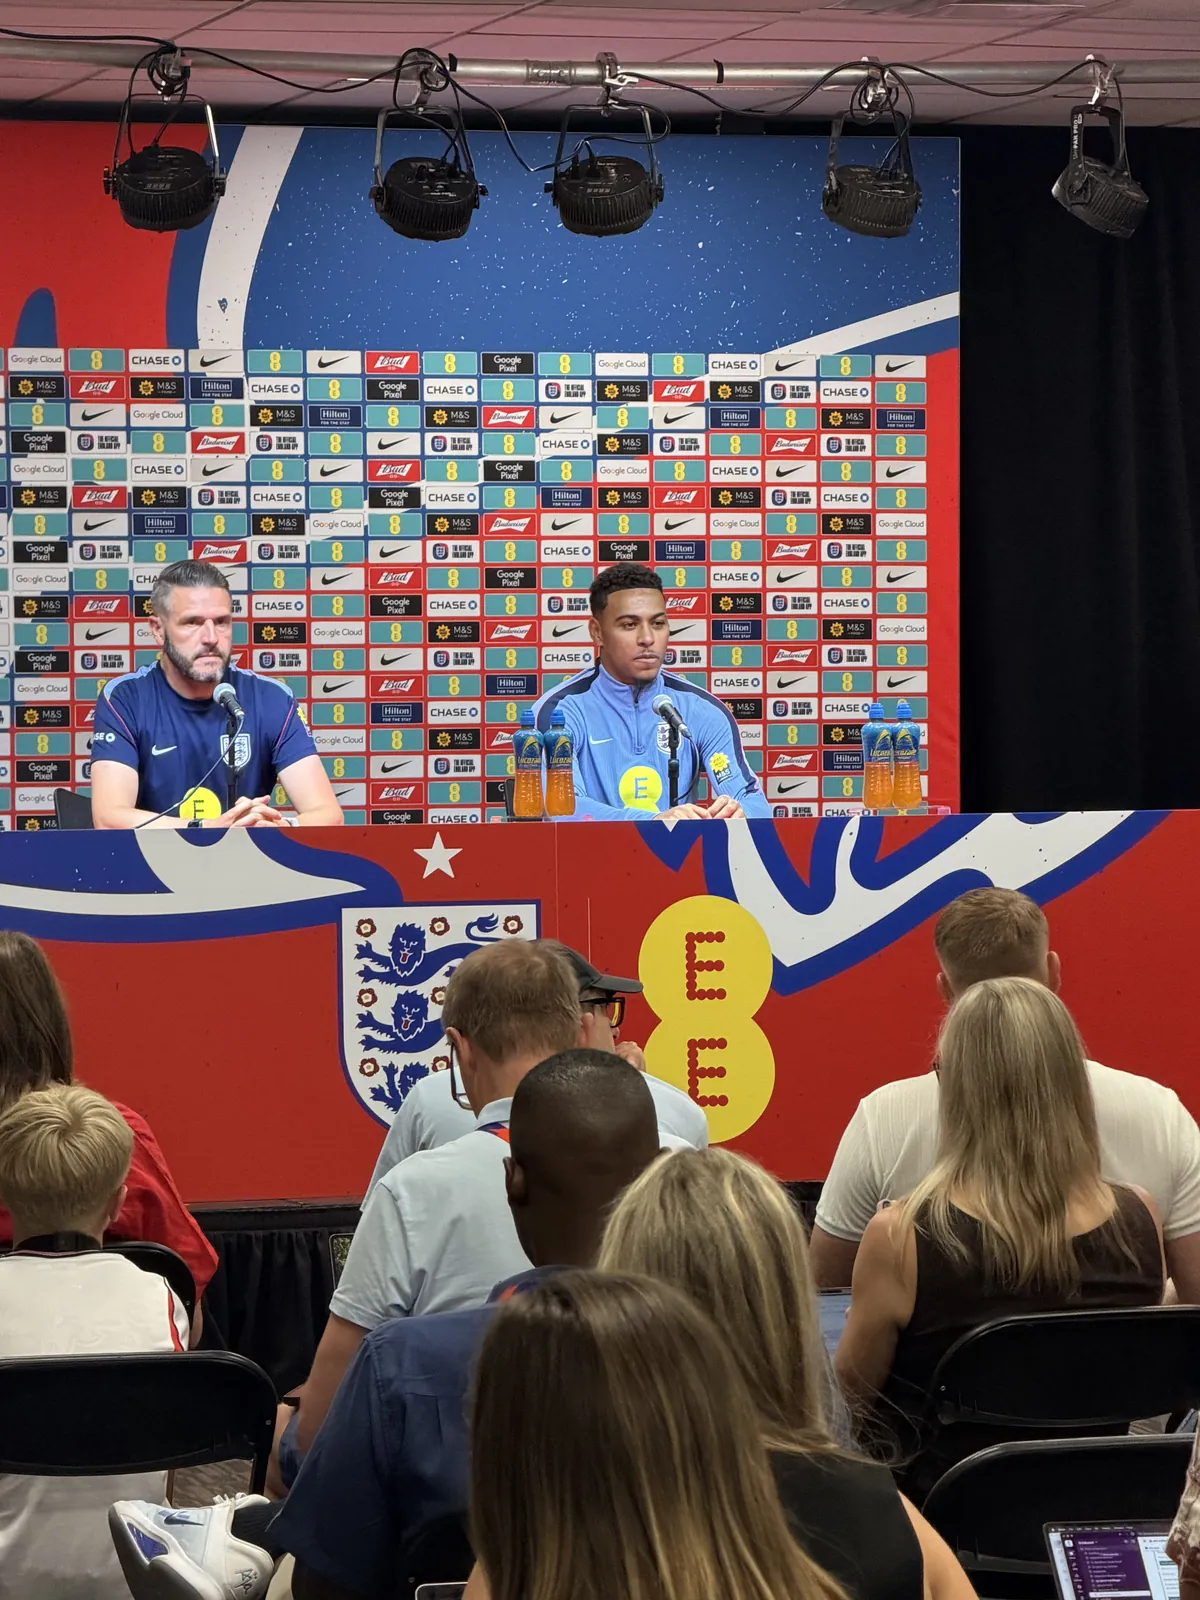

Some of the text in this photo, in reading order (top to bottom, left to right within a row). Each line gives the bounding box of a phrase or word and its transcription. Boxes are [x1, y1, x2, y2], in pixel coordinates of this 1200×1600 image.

[11, 354, 37, 364] Google
[132, 356, 169, 364] CHASE
[494, 355, 521, 364] Google
[598, 359, 623, 368] Google
[499, 364, 516, 372] Pixel
[157, 381, 176, 389] M&S
[251, 384, 288, 392] CHASE
[378, 381, 406, 390] Google
[734, 385, 752, 393] M&S
[384, 390, 401, 398] Pixel
[133, 410, 182, 419] Google Cloud
[276, 409, 295, 417] M&S
[846, 412, 863, 420] M&S
[23, 434, 52, 443] Google
[201, 437, 236, 445] Budweiser
[622, 438, 641, 446] M&S
[775, 439, 808, 447] Budweiser
[14, 465, 40, 474] Google
[134, 465, 171, 473] CHASE
[495, 463, 522, 471] Google
[600, 466, 624, 475] Google
[253, 493, 290, 501] CHASE
[380, 489, 408, 498] Google
[428, 493, 464, 501] CHASE
[623, 491, 641, 499] M&S
[735, 491, 753, 499] M&S
[386, 498, 403, 506] Pixel
[147, 518, 172, 526] Hilton
[278, 518, 297, 526] M&S
[313, 520, 338, 529] Google
[452, 518, 471, 526] M&S
[494, 519, 527, 527] Budweiser
[713, 519, 737, 528] Google
[879, 520, 902, 528] Google
[26, 544, 54, 552] Google
[203, 546, 238, 554] Budweiser
[610, 543, 637, 551] Google
[136, 574, 157, 582] CHA
[496, 570, 524, 579] Google
[16, 574, 66, 584] Google Cloud
[41, 600, 60, 608] M&S
[382, 597, 409, 606] Google
[314, 628, 339, 637] Google
[495, 626, 528, 634] Budweiser
[879, 624, 924, 633] Google Cloud
[27, 653, 56, 662] Google
[545, 653, 579, 661] CHASE
[776, 650, 809, 658] Budweiser
[33, 662, 51, 670] Pixel
[714, 678, 748, 686] CHASE
[17, 684, 67, 694] Google Cloud
[42, 710, 61, 718] M&S
[430, 708, 466, 716] CHASE
[315, 735, 363, 745] Google Cloud
[777, 755, 809, 763] Budweiser
[836, 754, 859, 762] Hilton
[28, 763, 57, 772] Google
[17, 793, 44, 803] Google
[825, 808, 849, 816] CHA
[383, 812, 410, 821] Google
[44, 819, 57, 827] M&
